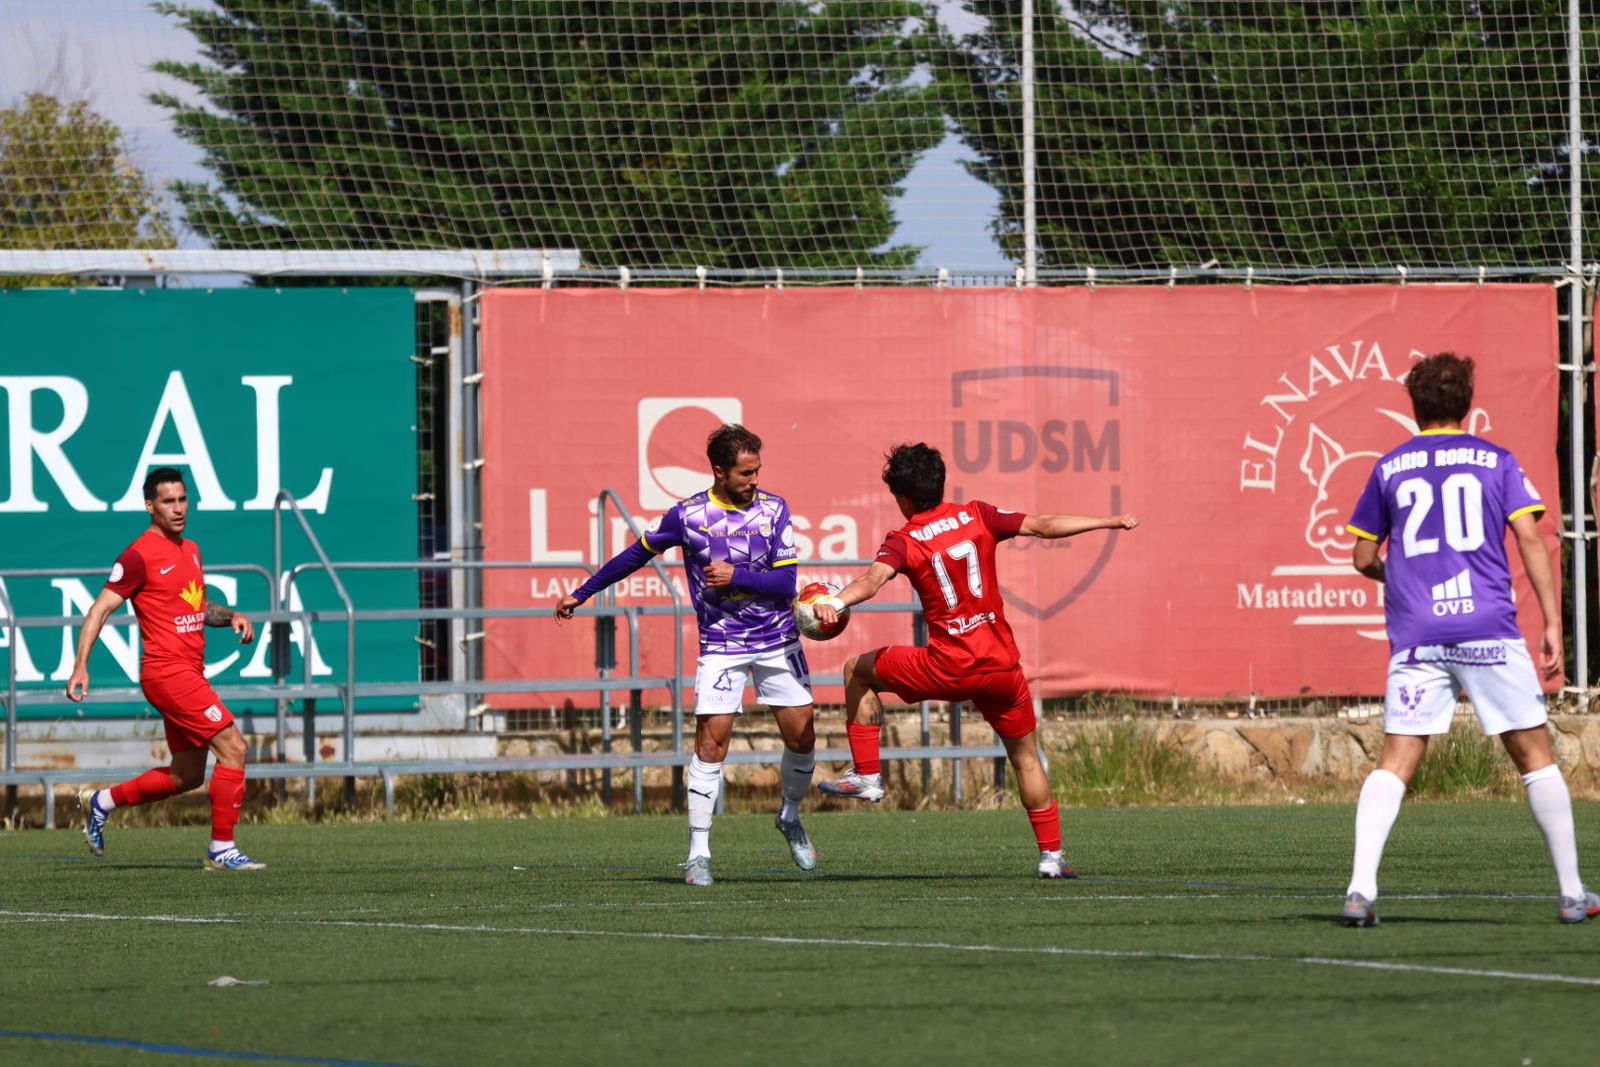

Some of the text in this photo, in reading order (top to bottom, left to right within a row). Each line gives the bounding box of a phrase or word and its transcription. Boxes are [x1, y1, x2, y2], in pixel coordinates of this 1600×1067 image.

[0, 370, 334, 515] RAL
[952, 419, 1121, 474] UDSM
[1240, 424, 1284, 494] EL
[1434, 447, 1498, 469] ROBLES
[529, 489, 859, 562] Limsa
[909, 517, 960, 542] ALONSO
[1395, 472, 1485, 559] 20
[531, 572, 685, 599] LAVDERÍA
[931, 539, 983, 610] 17
[1236, 583, 1367, 608] Matadero
[1432, 598, 1475, 617] OVB
